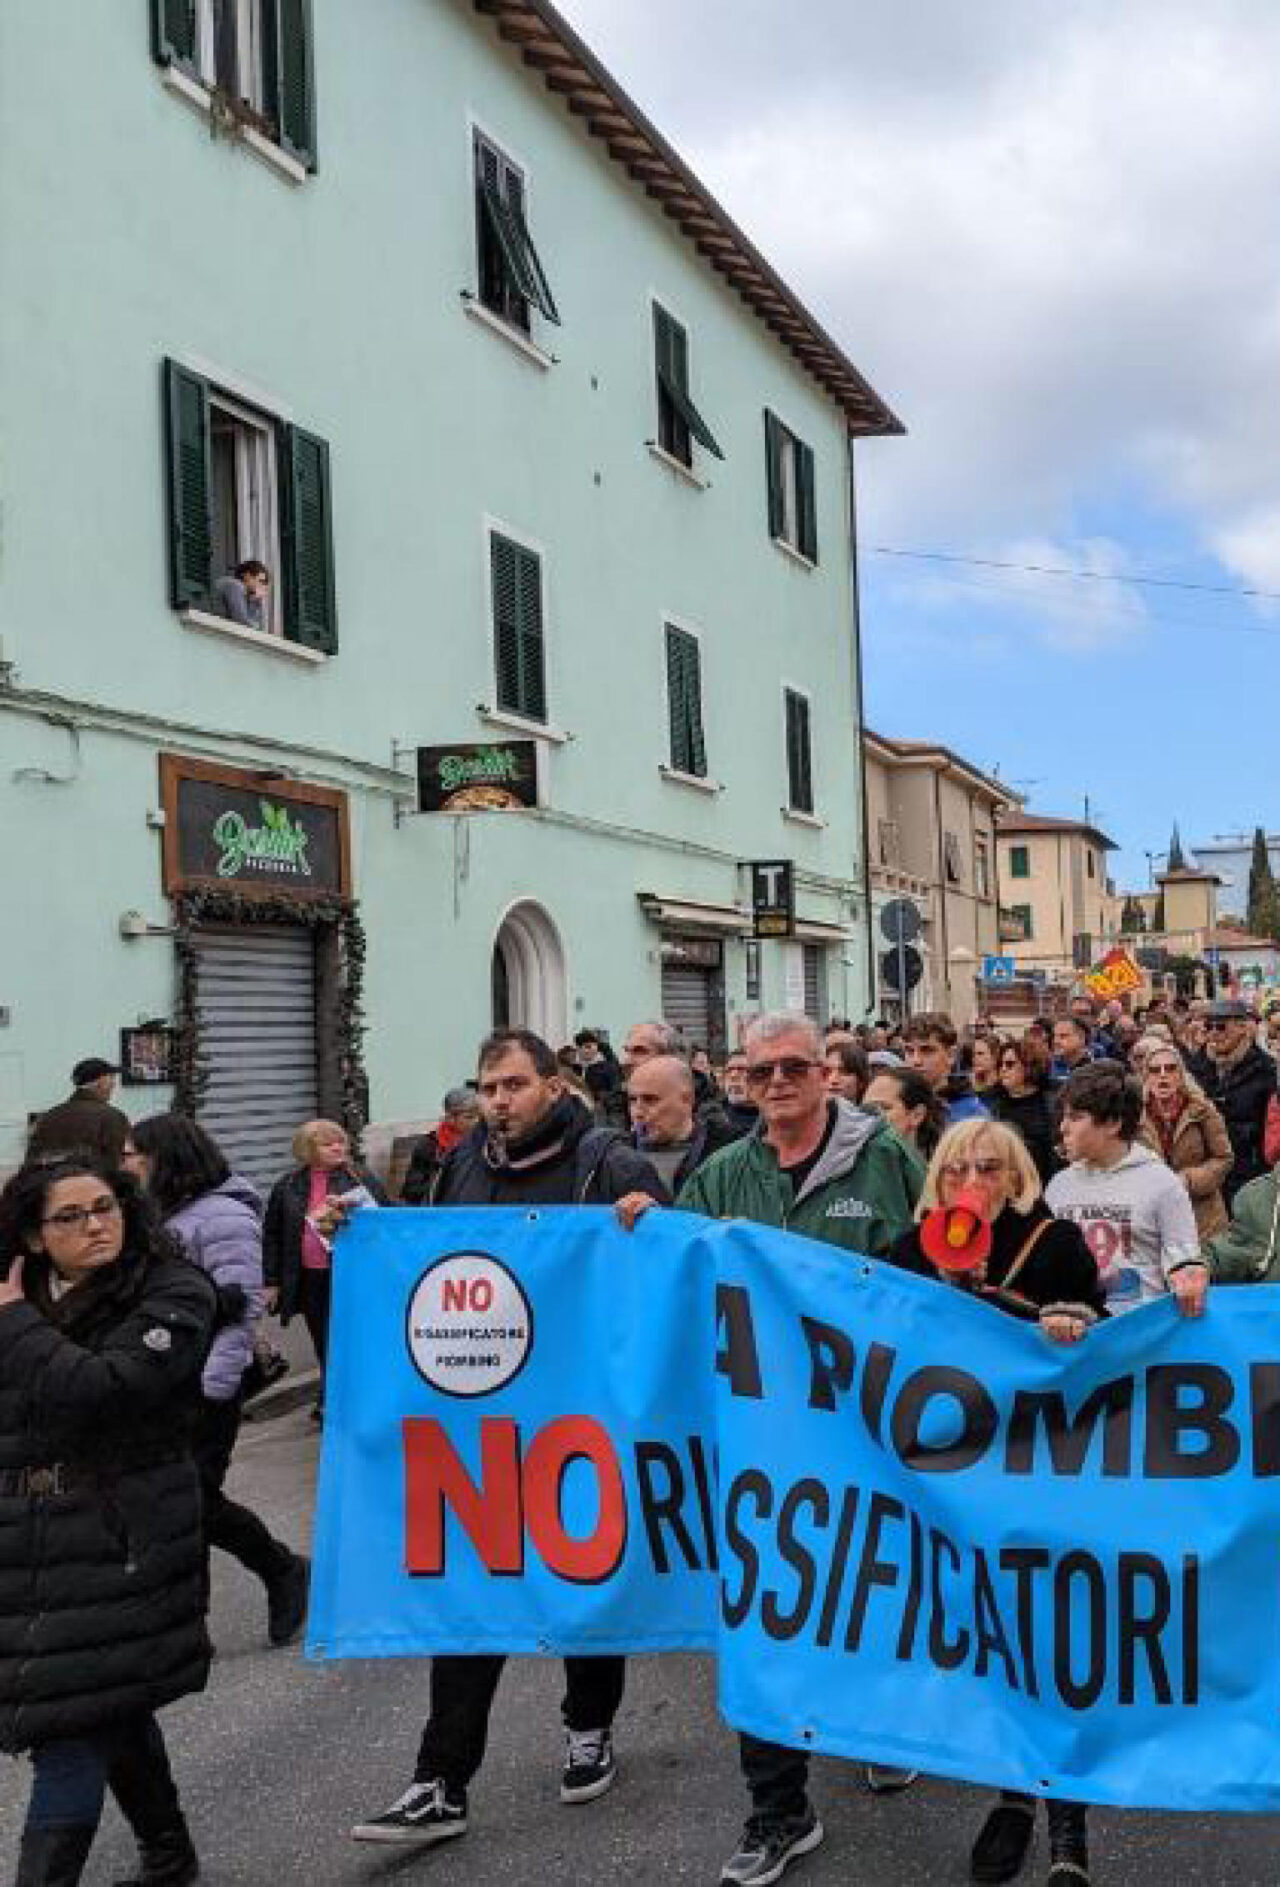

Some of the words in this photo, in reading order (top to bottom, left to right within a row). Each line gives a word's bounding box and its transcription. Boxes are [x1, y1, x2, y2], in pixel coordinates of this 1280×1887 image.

[758, 866, 784, 906] T
[440, 1277, 494, 1313] NO
[401, 1413, 628, 1587] NO
